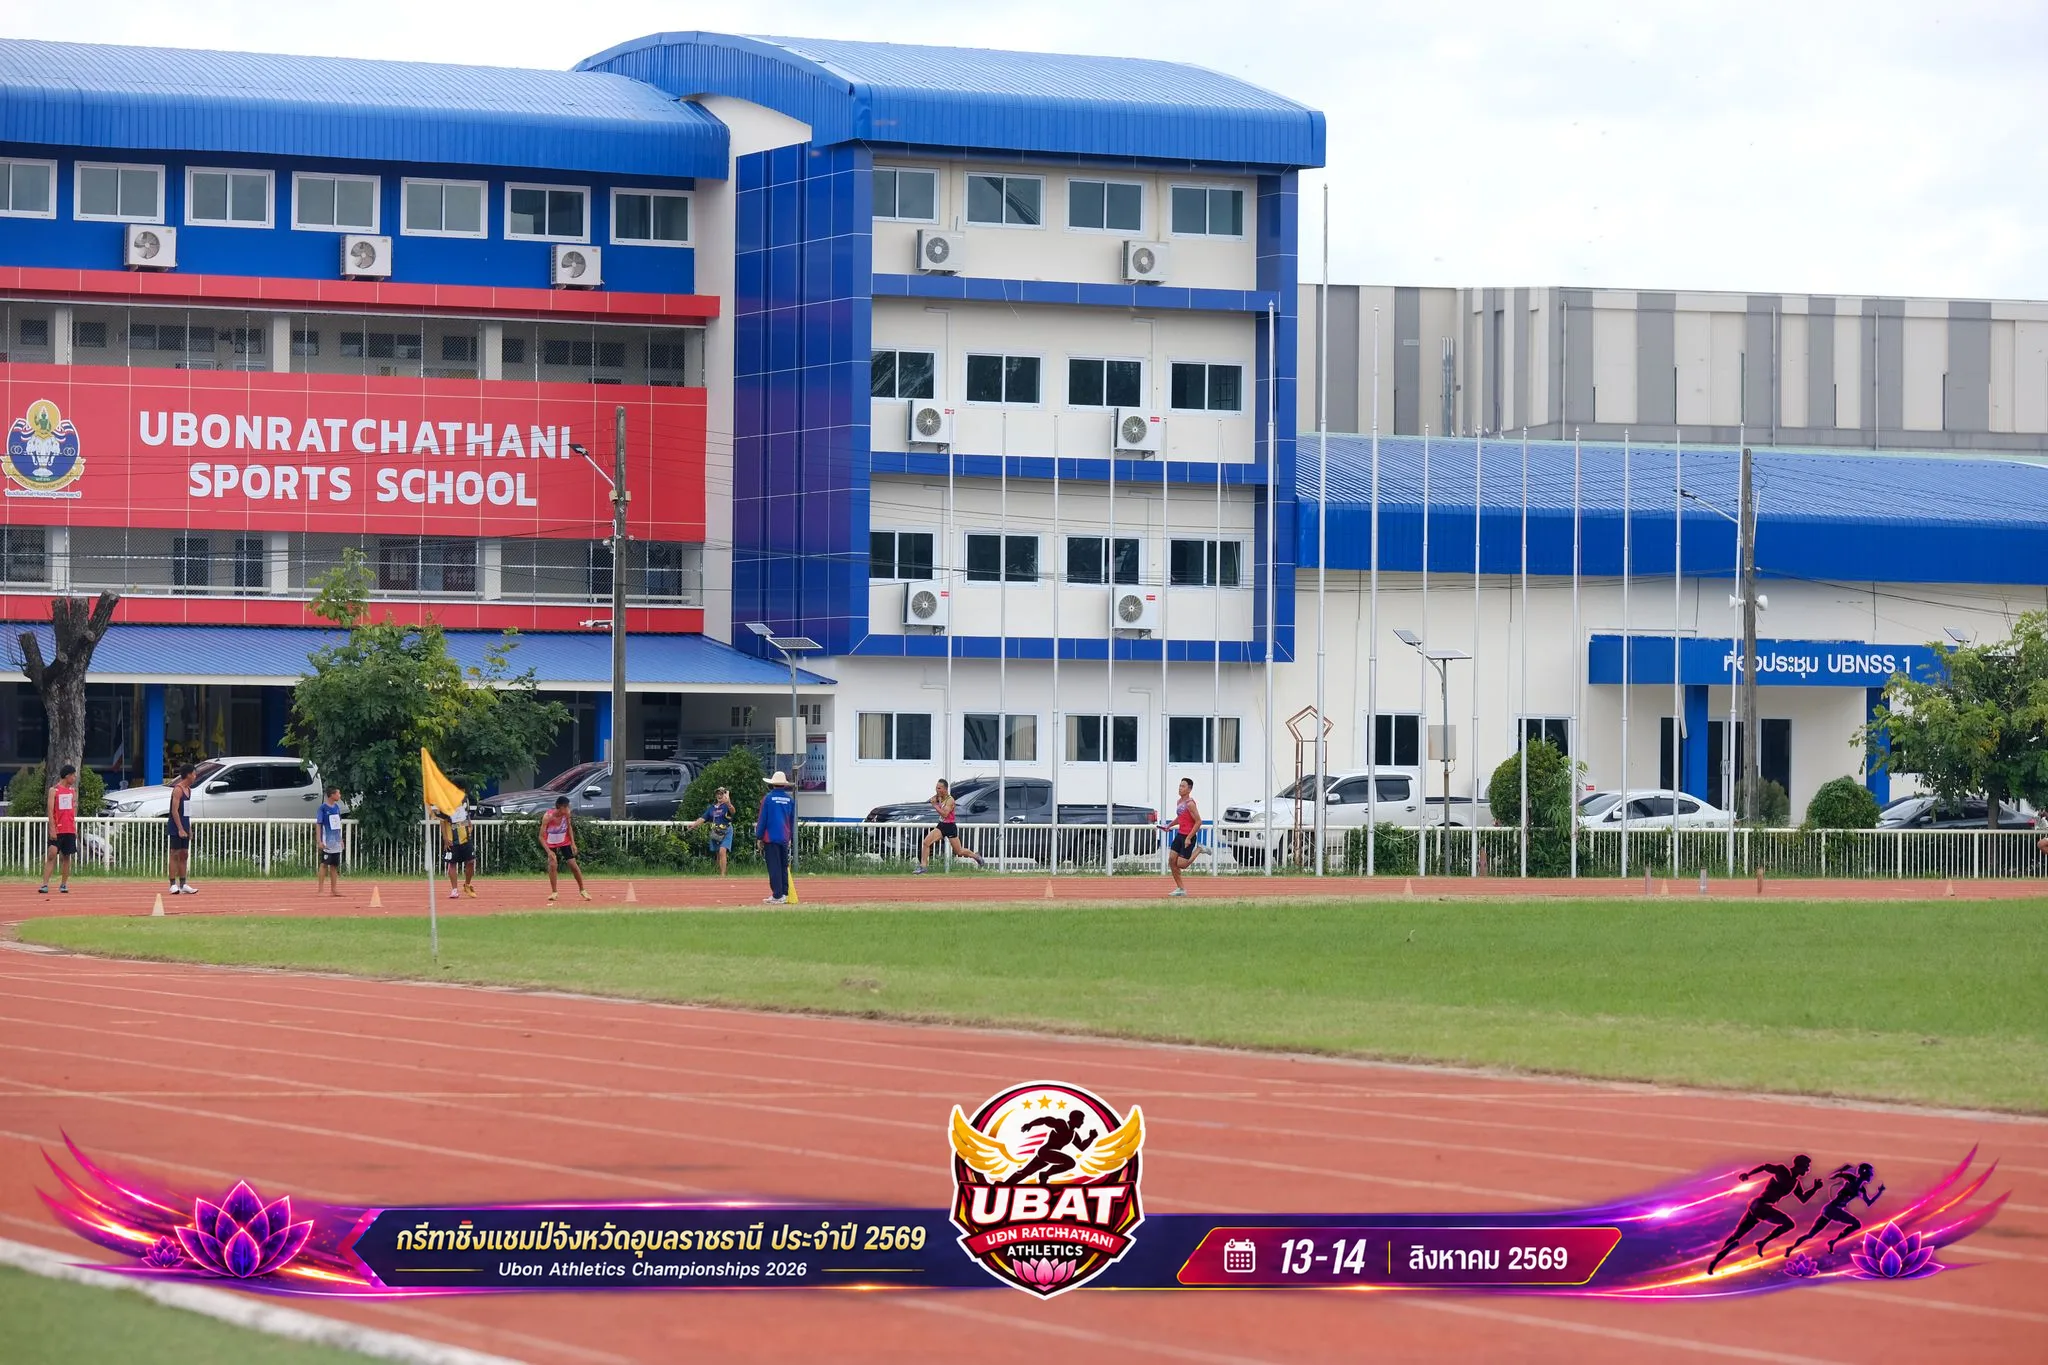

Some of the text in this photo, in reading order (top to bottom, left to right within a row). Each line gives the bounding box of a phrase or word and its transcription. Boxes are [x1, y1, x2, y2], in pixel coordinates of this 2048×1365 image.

[138, 410, 571, 460] UBONRATCHATHANI
[188, 461, 538, 507] SPORTS SCHOOL
[1827, 654, 1896, 674] UBNSS
[1903, 655, 1911, 674] 1
